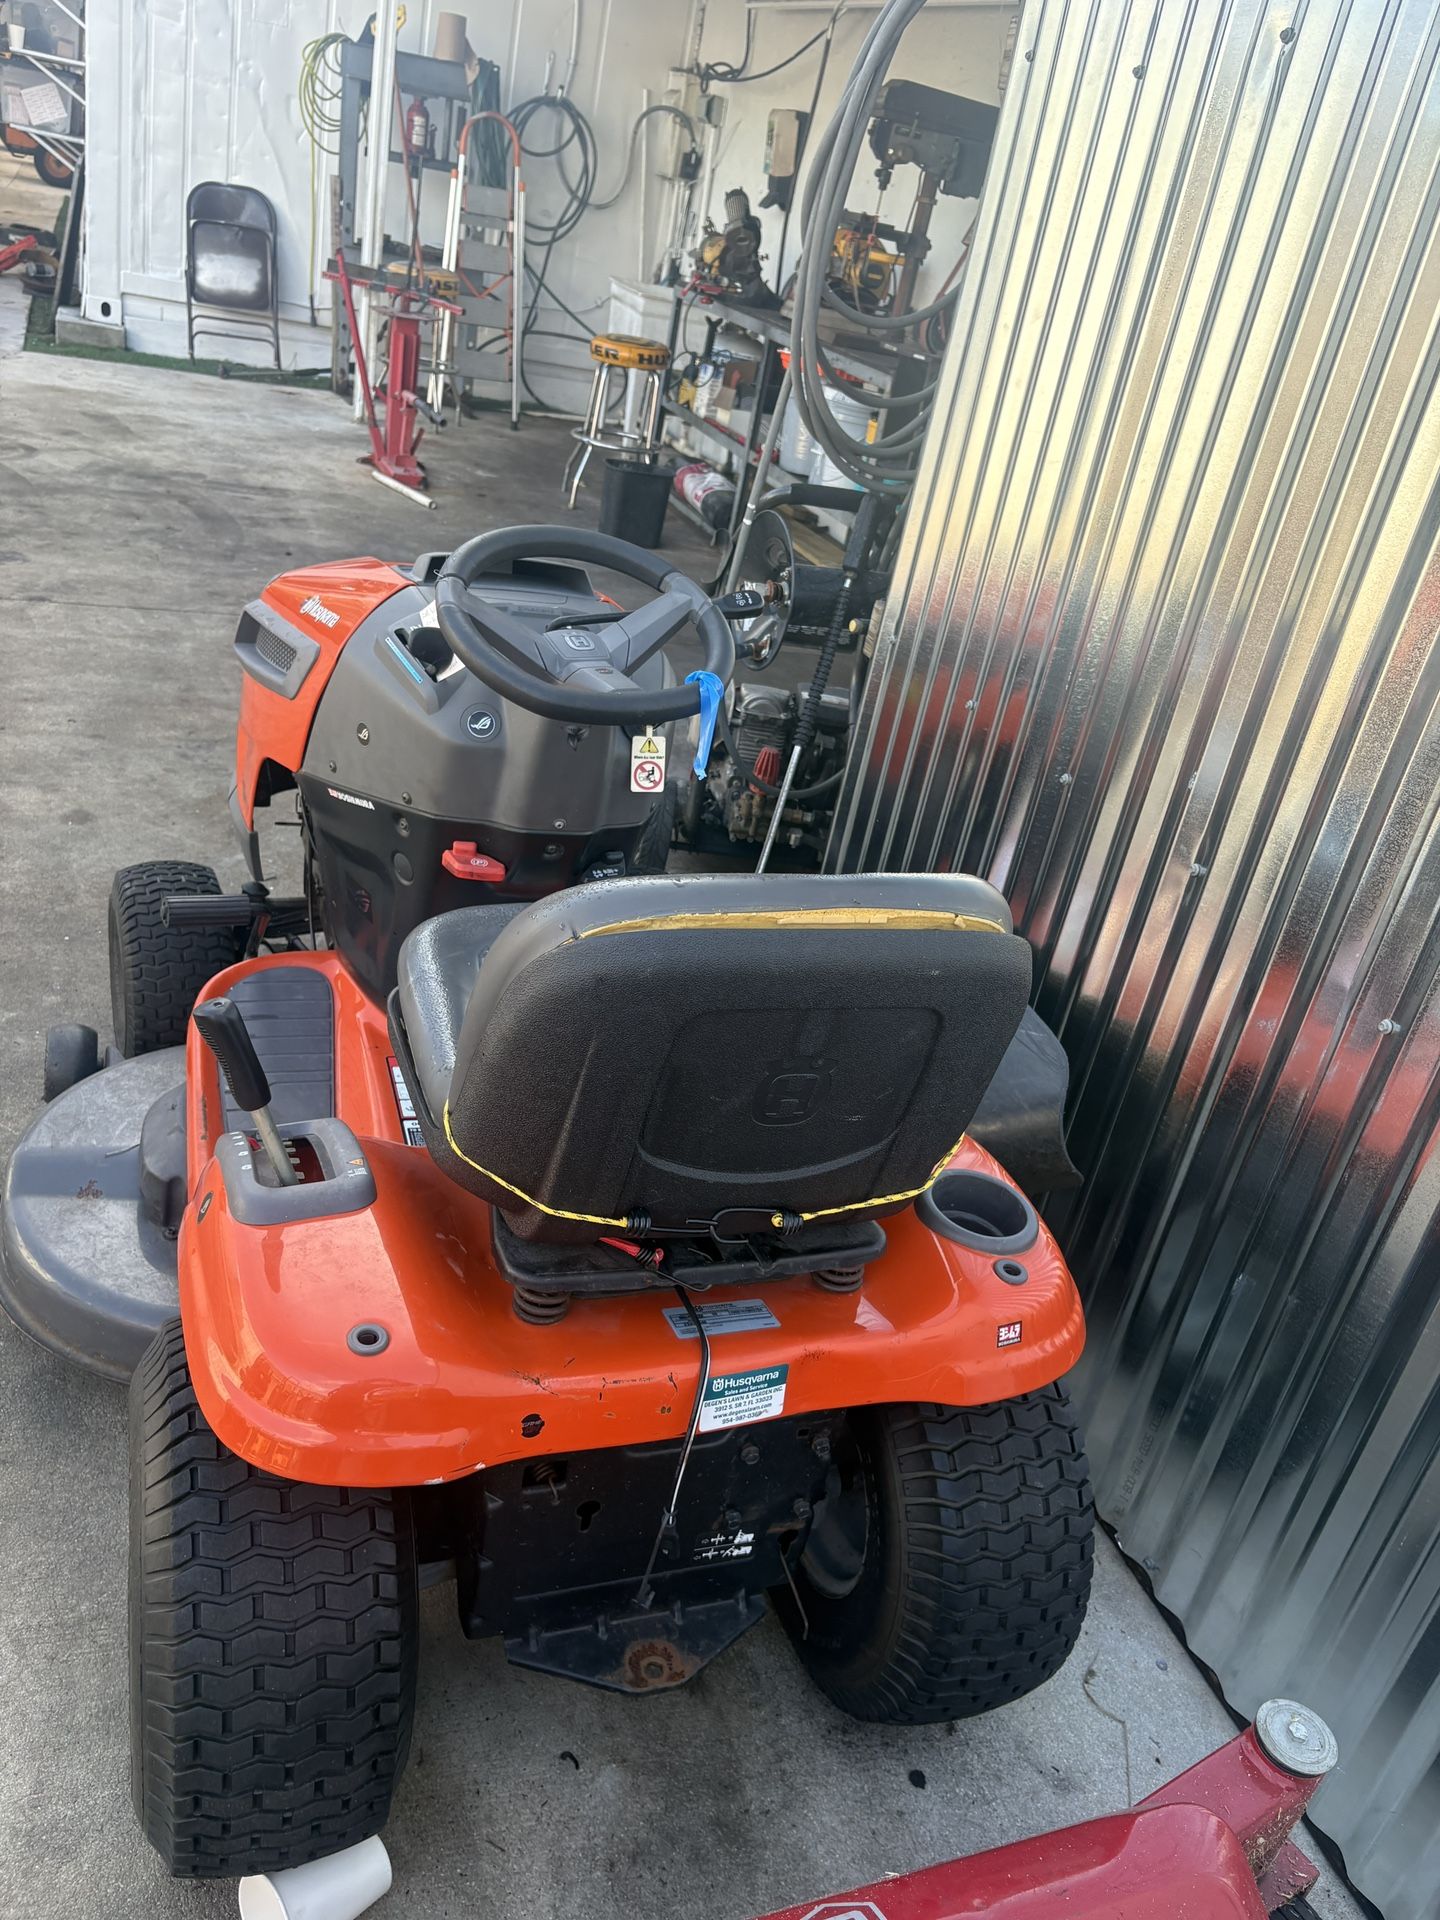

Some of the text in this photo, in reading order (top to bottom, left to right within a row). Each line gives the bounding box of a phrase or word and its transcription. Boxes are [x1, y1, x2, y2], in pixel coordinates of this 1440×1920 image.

[724, 1371, 780, 1389] Husqvarna
[724, 1388, 739, 1396] Sales
[749, 1383, 768, 1391] Service
[727, 1394, 745, 1403] LAWN
[750, 1388, 773, 1398] GARDEN
